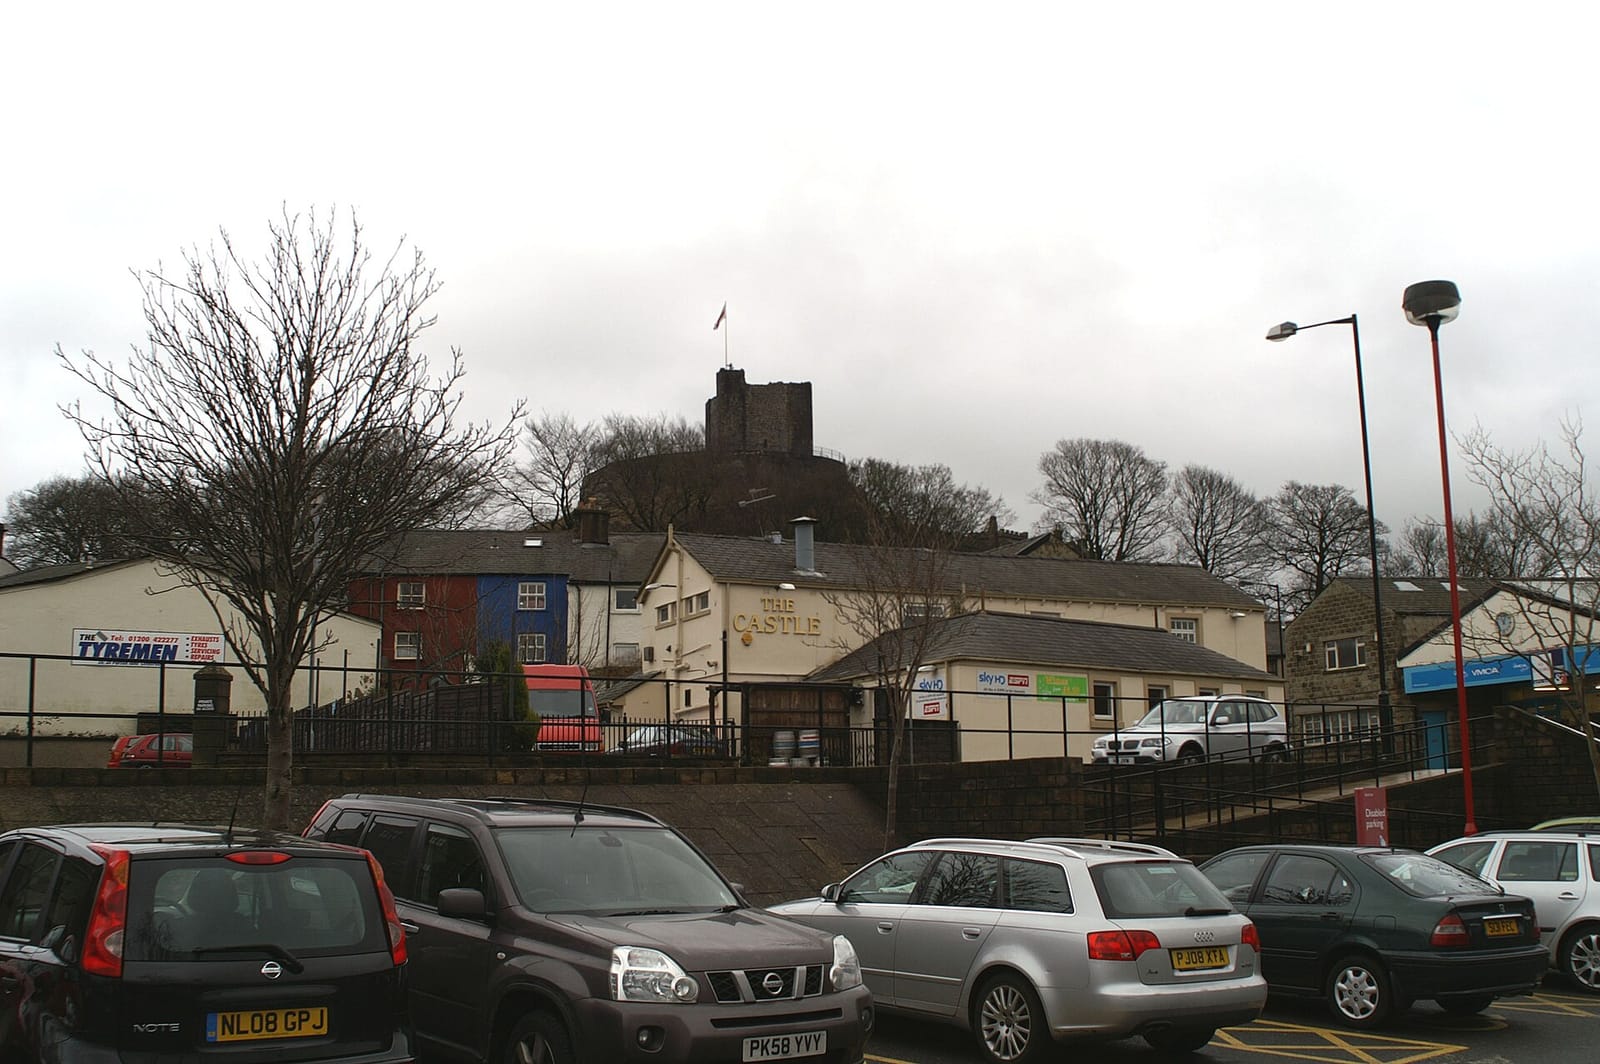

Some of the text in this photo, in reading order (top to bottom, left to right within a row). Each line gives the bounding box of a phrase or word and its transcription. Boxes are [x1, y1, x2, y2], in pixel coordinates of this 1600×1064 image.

[761, 598, 795, 613] THE
[733, 613, 821, 636] CASTLE
[79, 633, 97, 642] THE
[111, 634, 125, 643] Tel:
[128, 635, 151, 643] 01200
[191, 635, 220, 643] EXHAUSTS
[78, 641, 180, 661] TYREMEN
[1471, 666, 1500, 677] YMCA
[979, 671, 994, 686] sky
[1365, 808, 1386, 818] Disabled
[1365, 819, 1385, 831] parking
[1176, 950, 1205, 966] PJ08
[133, 1023, 181, 1032] NOTE
[221, 1009, 325, 1037] NL08 GPJ
[749, 1033, 821, 1058] PK58 YVY
